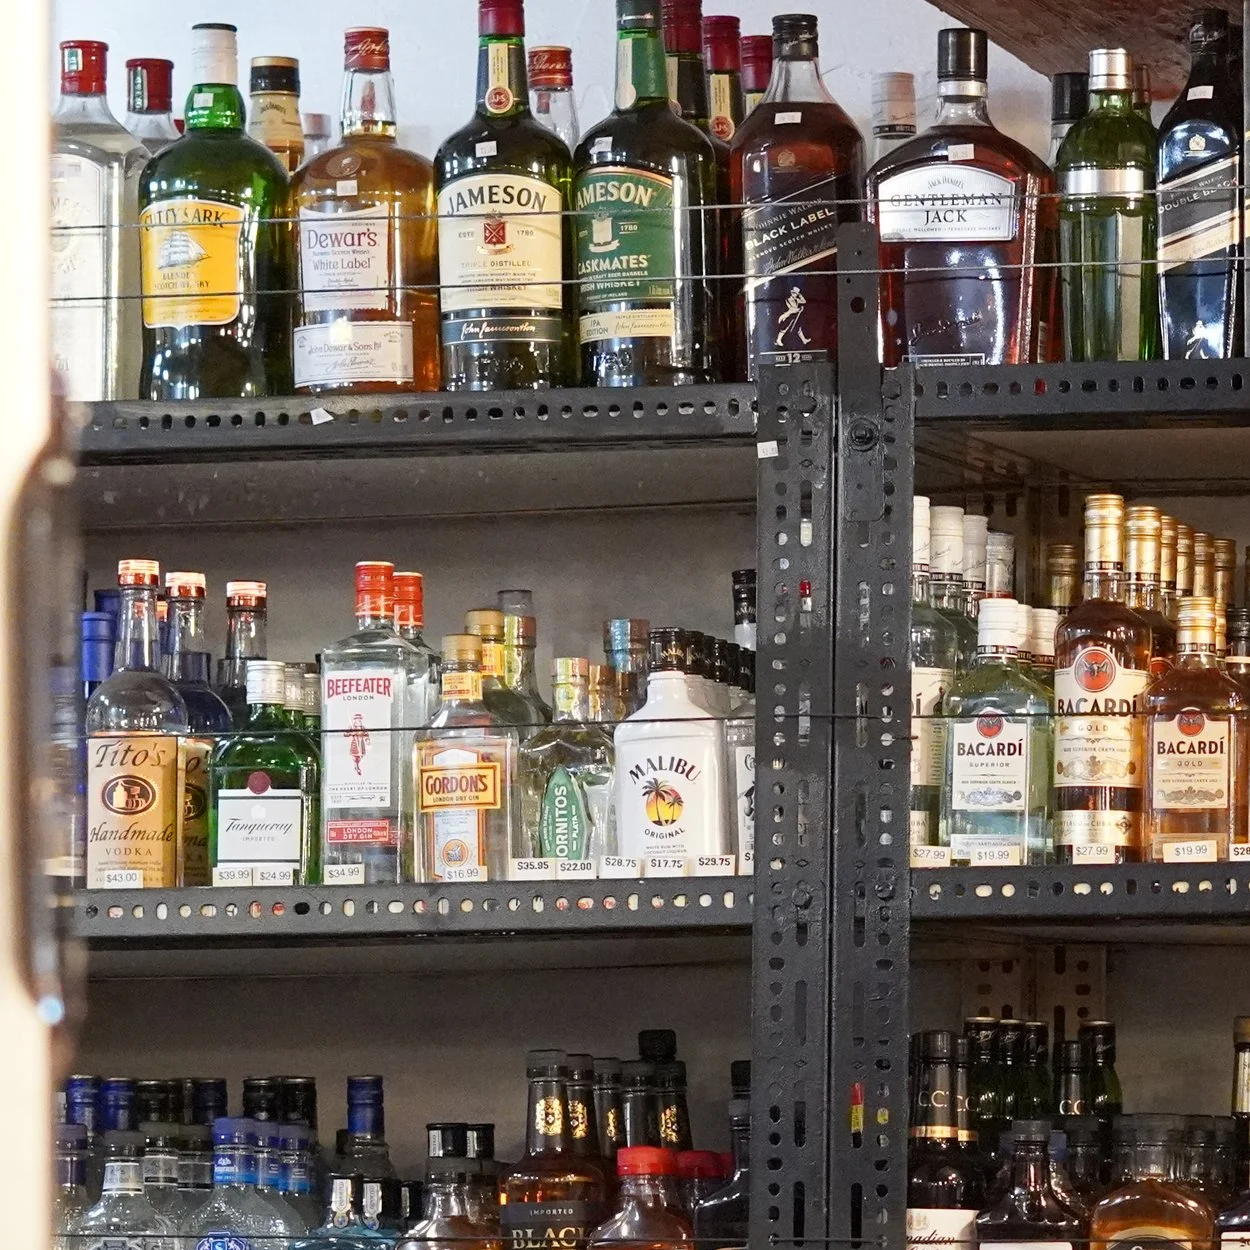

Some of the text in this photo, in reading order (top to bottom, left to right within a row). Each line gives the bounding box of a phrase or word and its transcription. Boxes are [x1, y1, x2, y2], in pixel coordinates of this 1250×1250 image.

[447, 186, 546, 215] JAMESON
[925, 210, 968, 224] JACK
[307, 227, 378, 250] Dewar's
[327, 678, 391, 698] BEEFEATER
[1079, 724, 1108, 732] GOLD
[957, 737, 1024, 756] BACARDÍ
[1157, 736, 1226, 755] BACARDÍ
[95, 740, 166, 768] Tito's
[629, 755, 701, 785] MALIBU
[425, 774, 488, 795] GORDON'S
[225, 818, 293, 835] Tanqueray
[90, 822, 174, 843] Handmade
[644, 827, 685, 840] ORIGINAL
[105, 848, 152, 856] VODKA
[913, 849, 945, 860] $27.99
[976, 851, 1009, 861] $19.99
[1075, 846, 1108, 856] $27.99
[1174, 845, 1207, 856] $19.99
[517, 861, 549, 871] $35.95
[560, 862, 592, 872] $22.00
[605, 858, 637, 867] $28.75
[106, 873, 137, 883] $43.00
[218, 870, 249, 880] $39.99
[259, 872, 291, 881] $24.99
[328, 868, 360, 878] $34.99
[446, 869, 479, 879] $16.99
